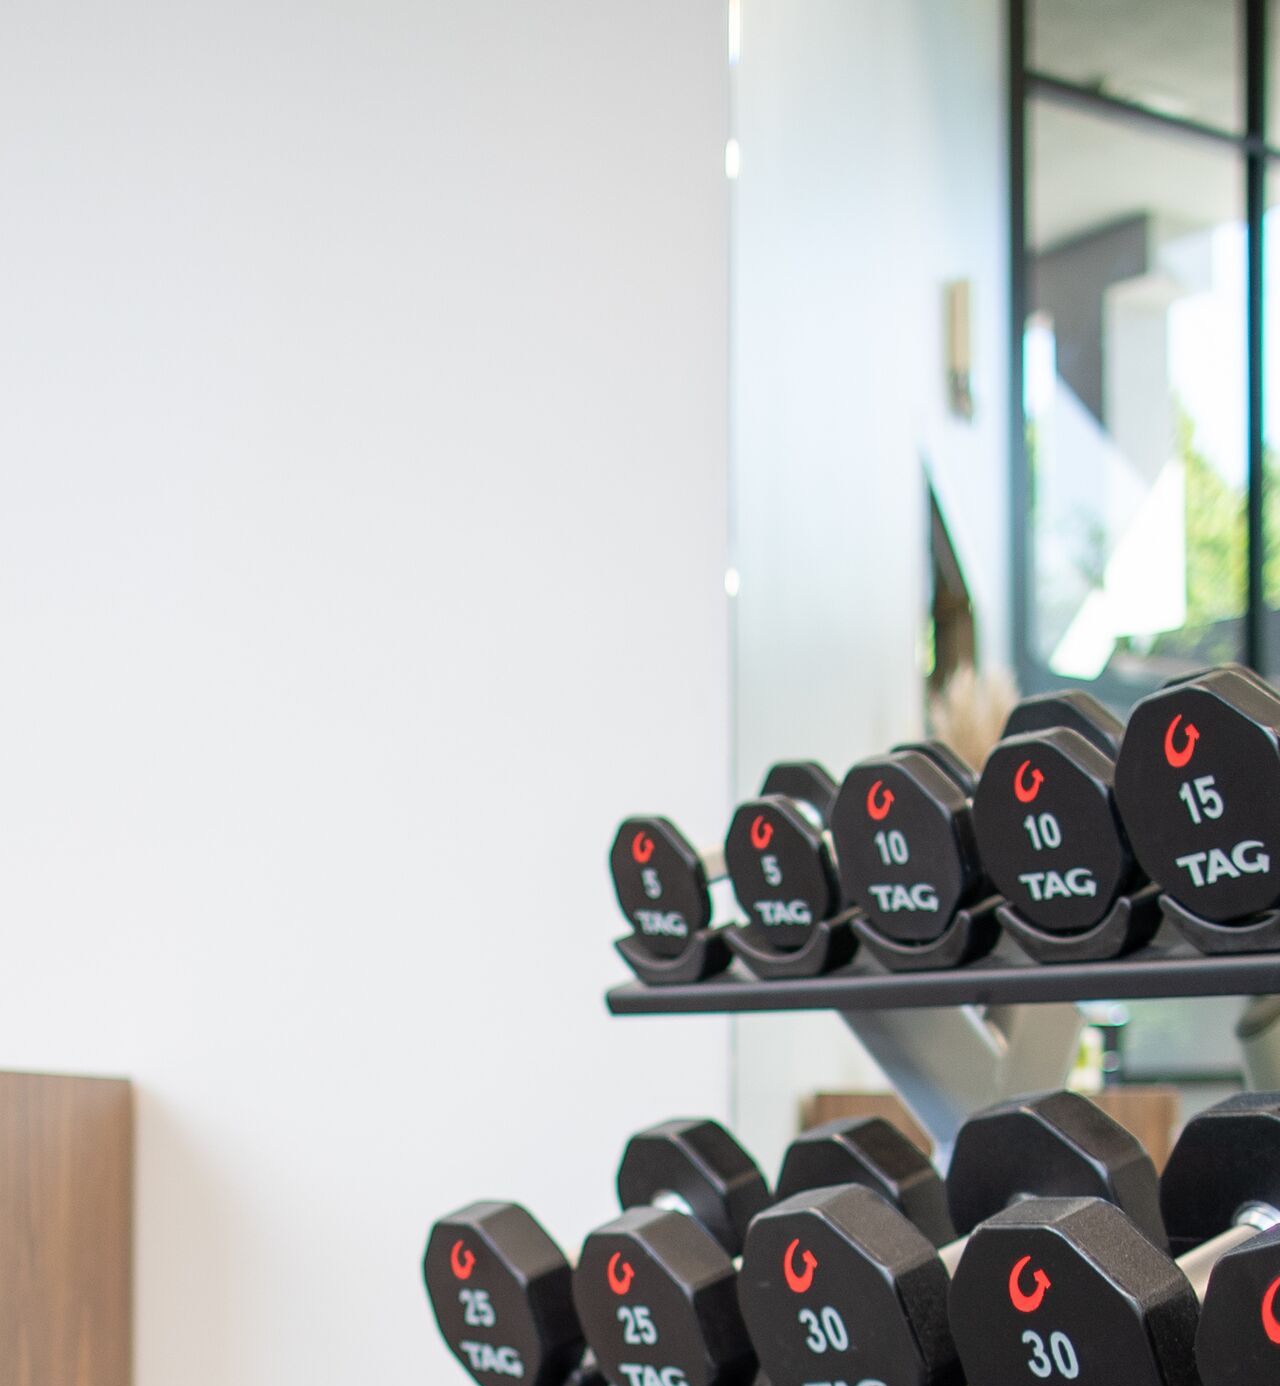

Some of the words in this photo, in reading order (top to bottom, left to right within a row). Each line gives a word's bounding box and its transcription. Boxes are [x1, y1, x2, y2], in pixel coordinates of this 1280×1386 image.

[1180, 776, 1223, 823] 15
[875, 831, 908, 864] 10
[1024, 814, 1061, 850] 10
[762, 856, 781, 885] 5
[1176, 841, 1269, 886] TAG
[643, 869, 661, 898] 5
[870, 884, 938, 911] TAG
[1020, 869, 1096, 899] TAG
[636, 911, 687, 936] TAG
[755, 901, 811, 924] TAG
[460, 1291, 495, 1326] 25
[618, 1306, 656, 1344] 25
[799, 1307, 848, 1353] 30
[460, 1342, 522, 1377] TAG
[1022, 1330, 1078, 1379] 30
